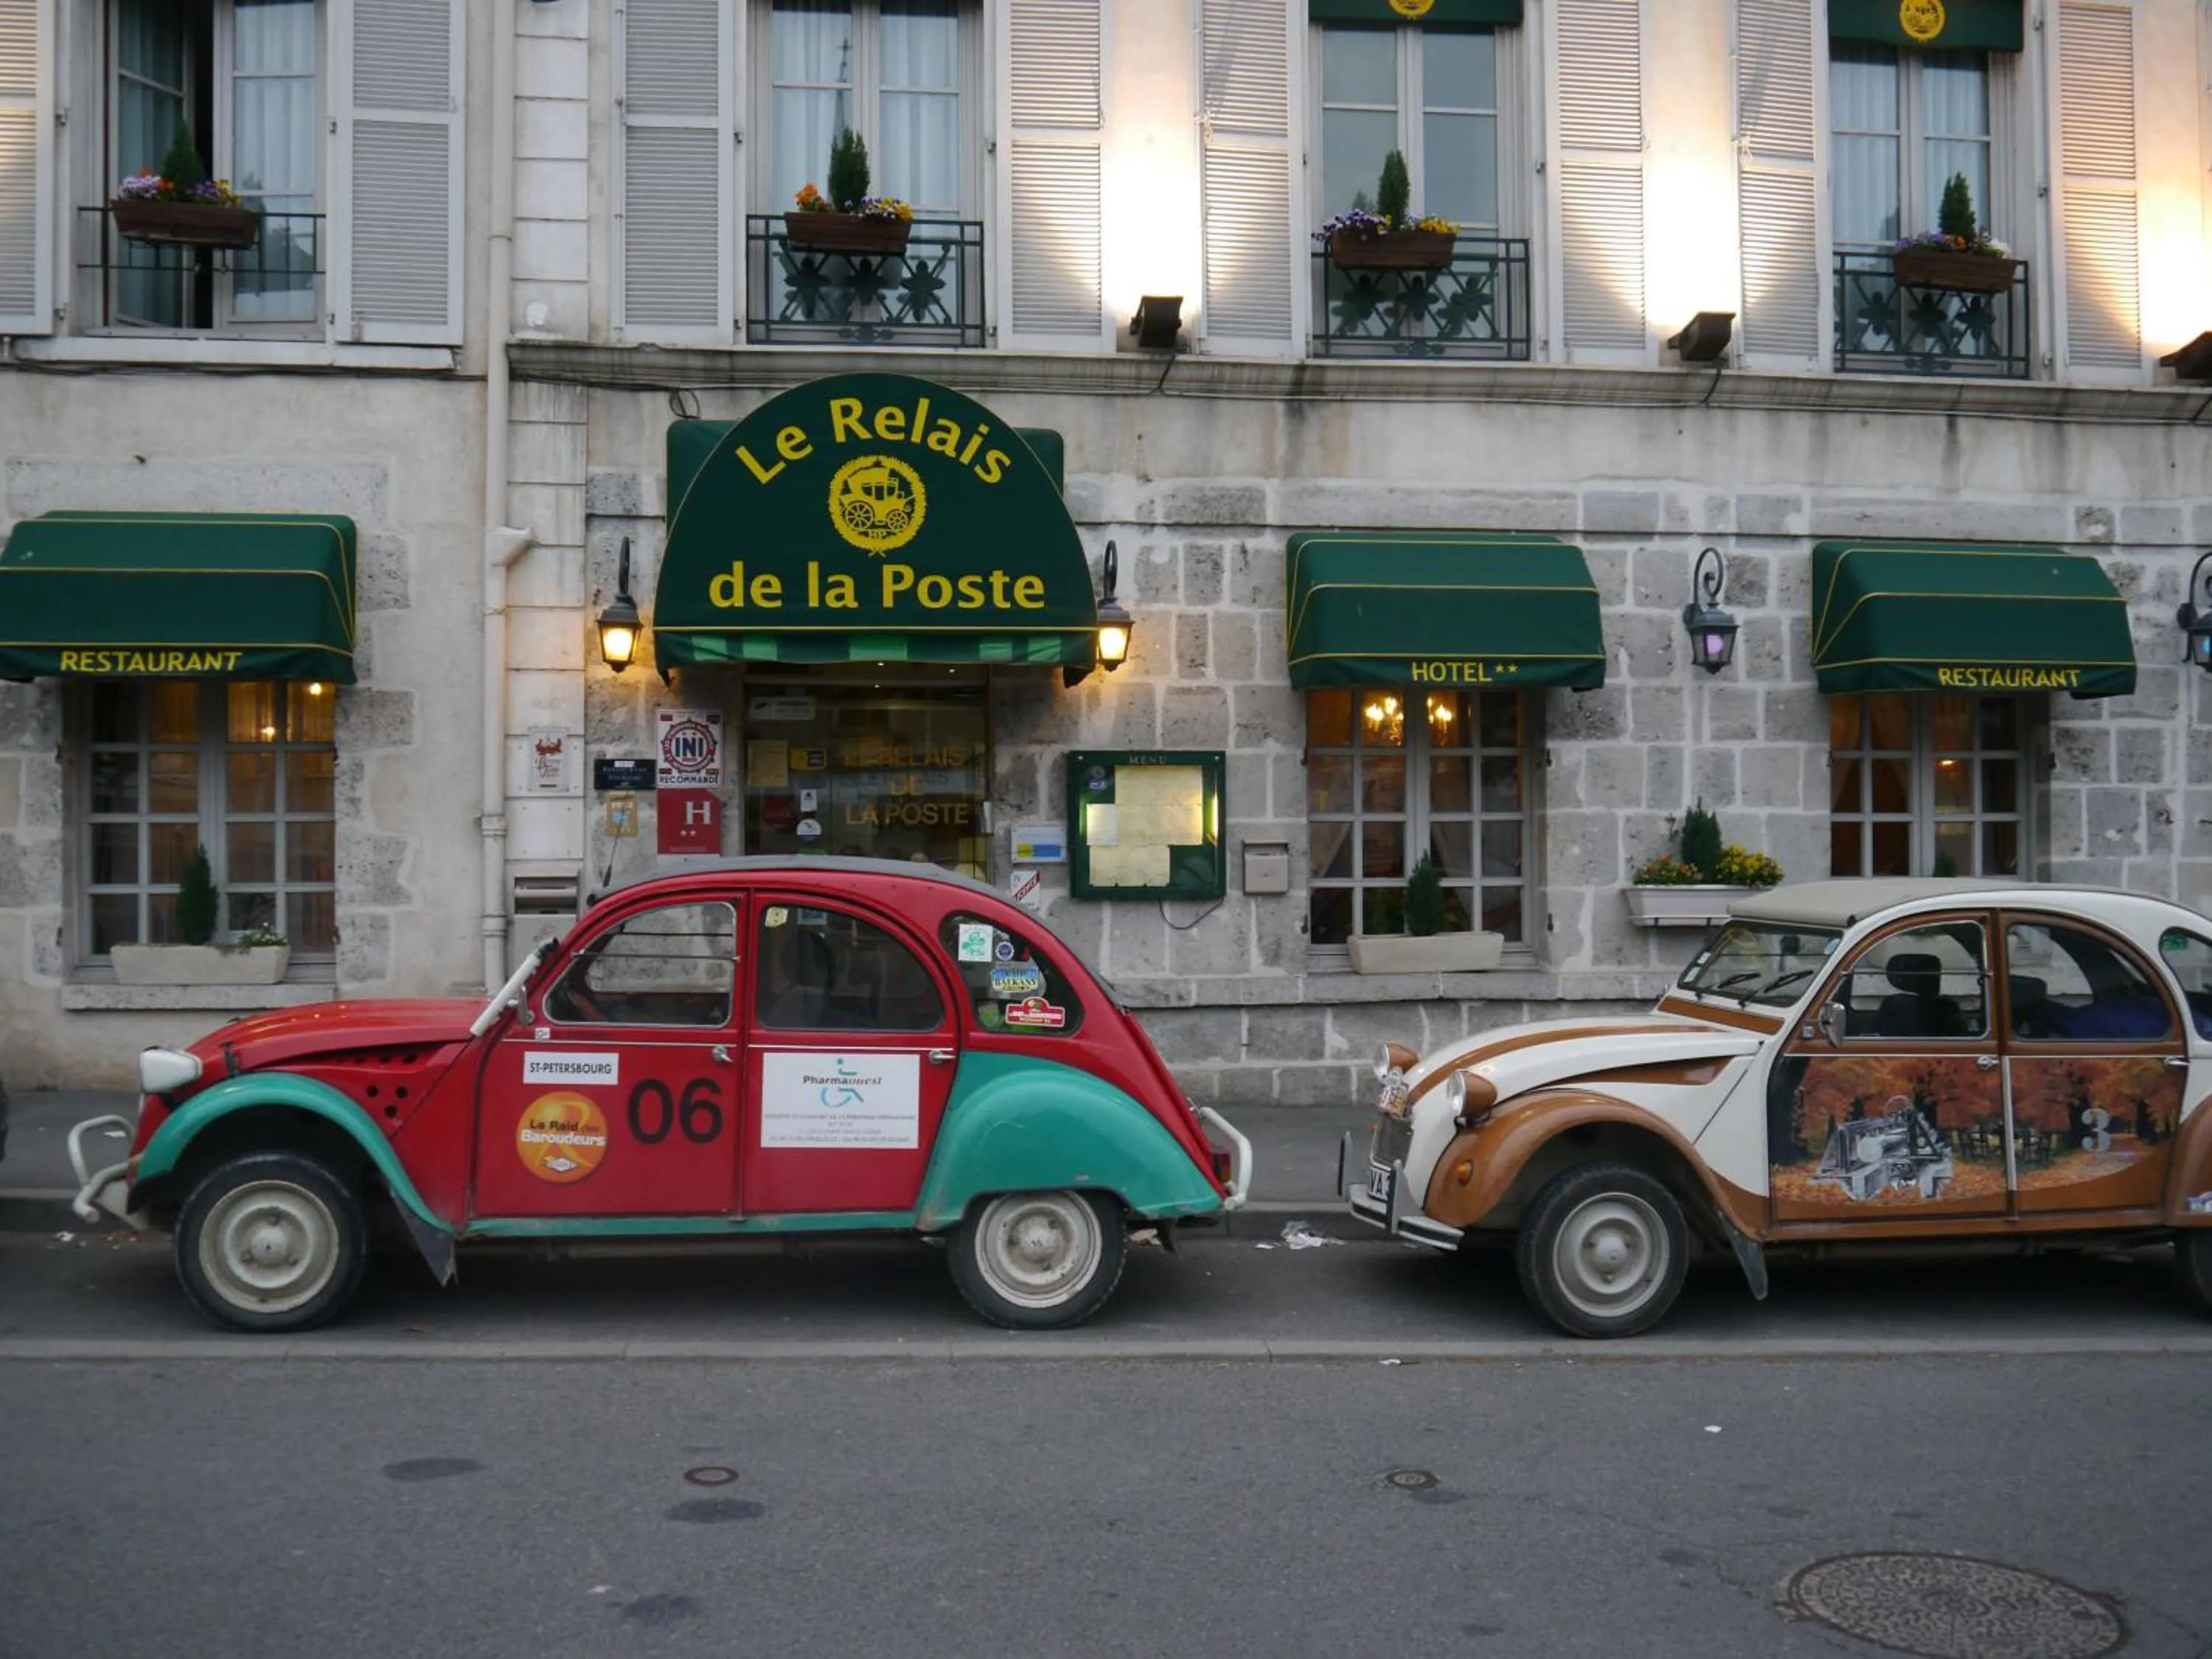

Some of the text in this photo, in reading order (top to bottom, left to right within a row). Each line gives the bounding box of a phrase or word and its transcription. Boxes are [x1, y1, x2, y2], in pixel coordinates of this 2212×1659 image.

[735, 397, 1012, 484] Le Relais
[709, 561, 1046, 609] de la Poste
[60, 650, 243, 672] RESTAURANT
[1411, 661, 1492, 682] HOTEL
[1938, 667, 2081, 686] RESTAURANT
[890, 774, 924, 796] DE
[685, 801, 712, 825] H
[845, 802, 969, 825] LA POSTE
[529, 1062, 612, 1074] ST-PETERSBOURG
[627, 1078, 723, 1145] 06
[529, 1119, 545, 1129] Le
[549, 1120, 579, 1131] Raid
[2081, 1107, 2111, 1154] 3
[521, 1129, 606, 1147] Baroudeurs
